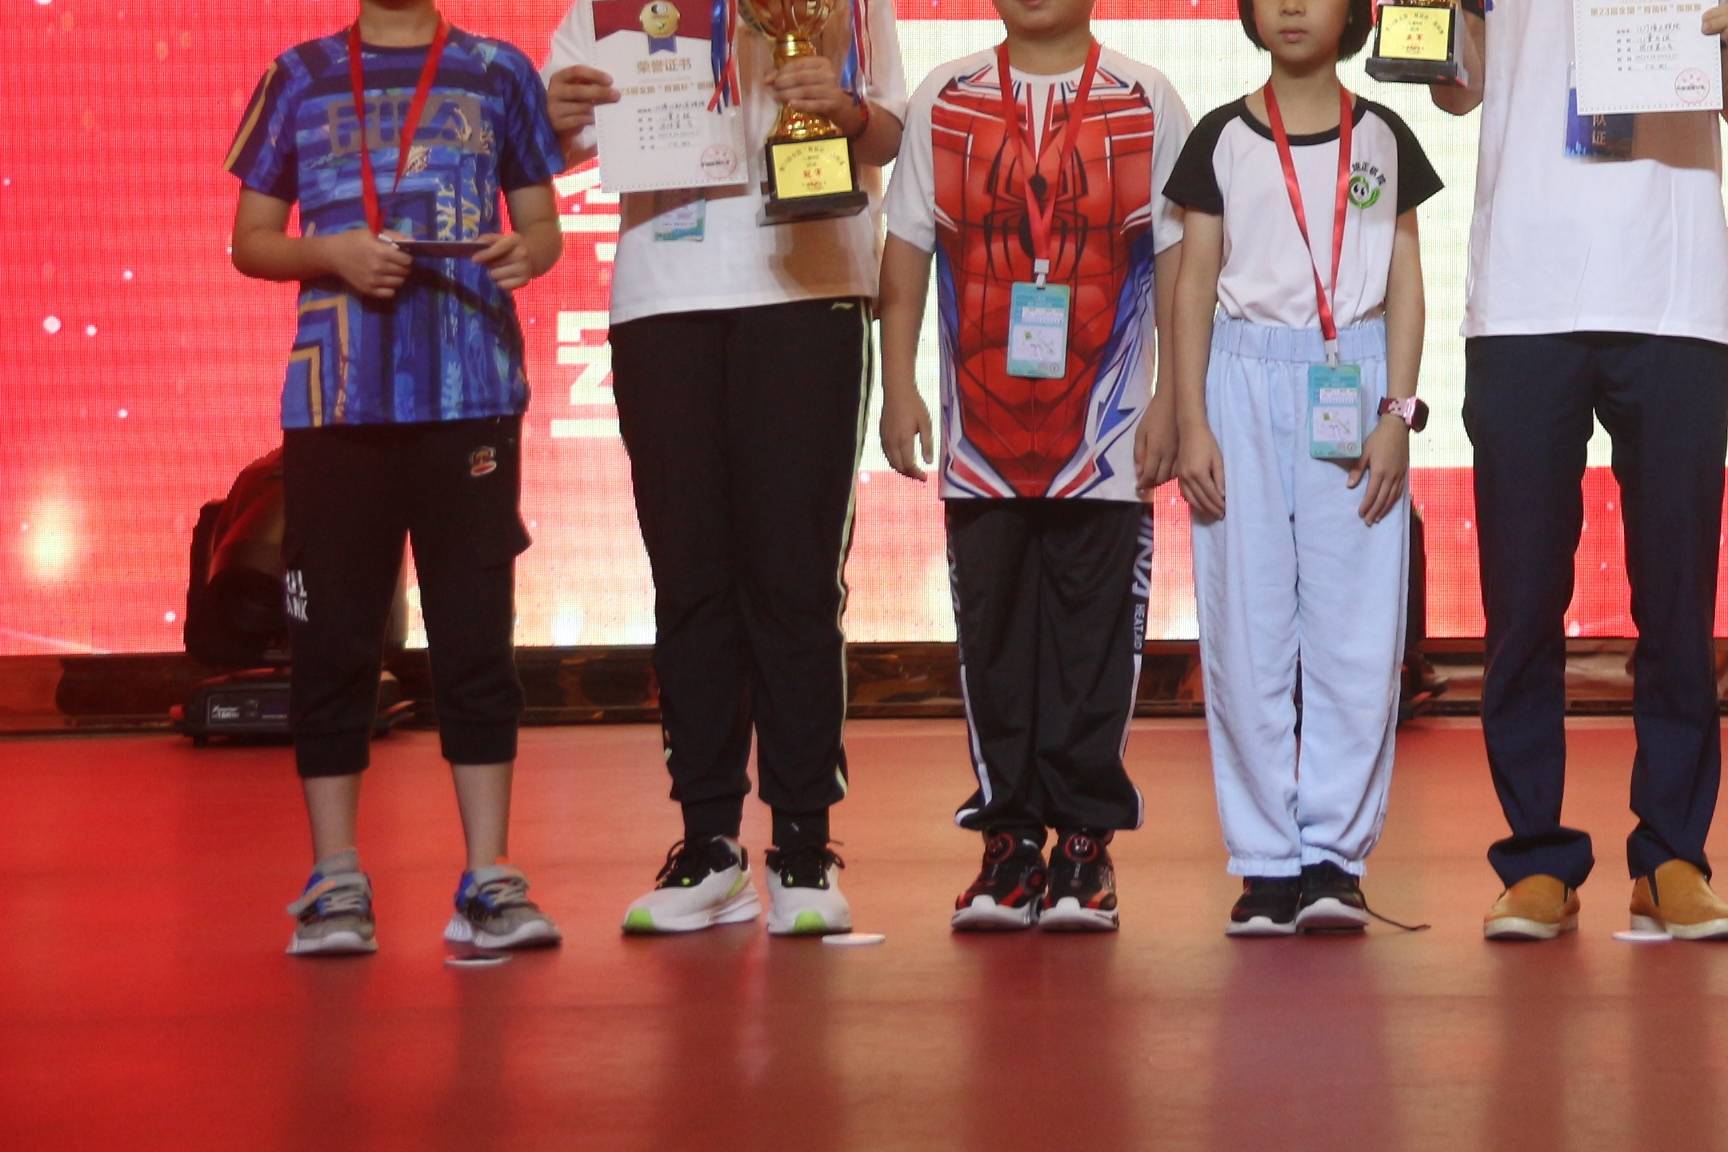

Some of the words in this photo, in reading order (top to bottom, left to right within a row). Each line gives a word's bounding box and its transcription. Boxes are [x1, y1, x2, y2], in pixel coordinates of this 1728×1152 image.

[637, 59, 692, 74] 荣誉证书
[337, 100, 471, 147] FILA
